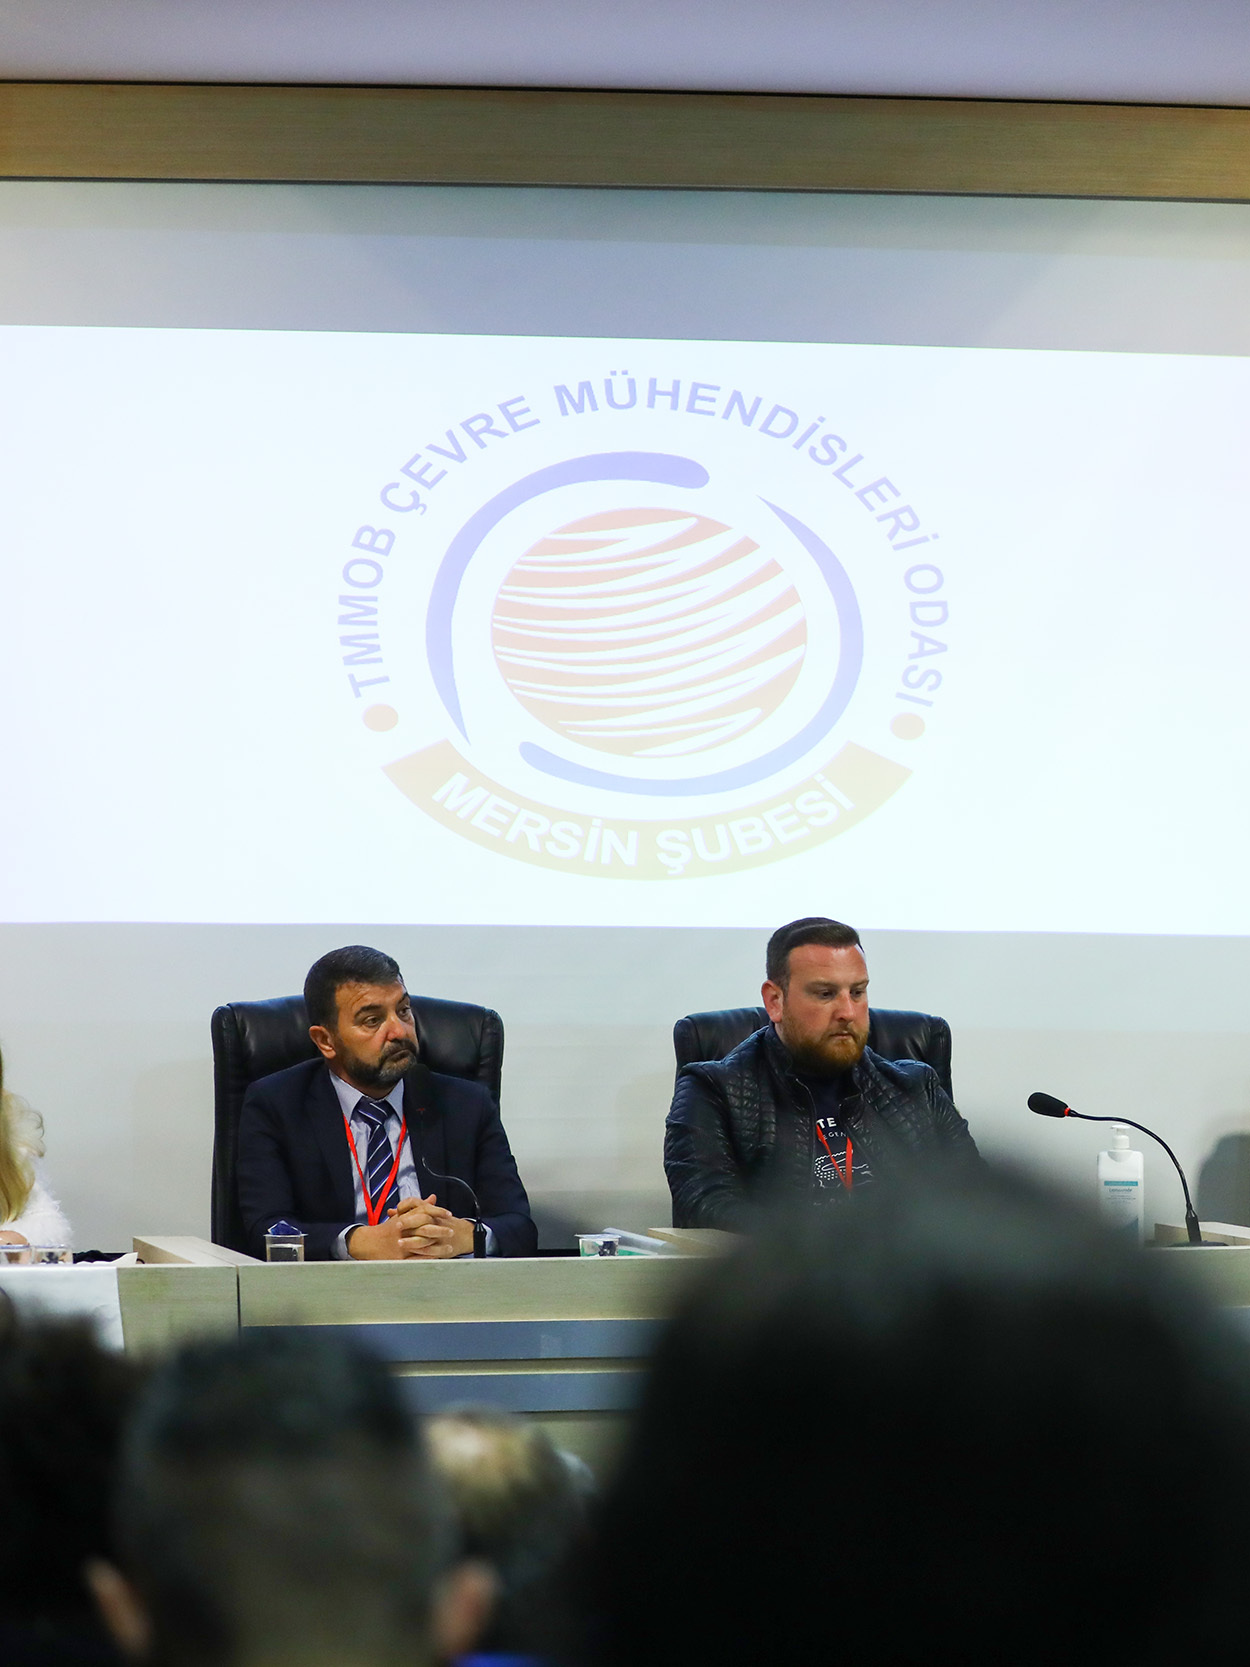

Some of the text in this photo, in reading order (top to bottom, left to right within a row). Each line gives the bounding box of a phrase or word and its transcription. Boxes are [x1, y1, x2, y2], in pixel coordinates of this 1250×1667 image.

[337, 370, 950, 708] TMMOB ÇEVRE MÜHENDİSLERİ ODASI
[431, 771, 856, 875] MERSİN ŞUBESİ
